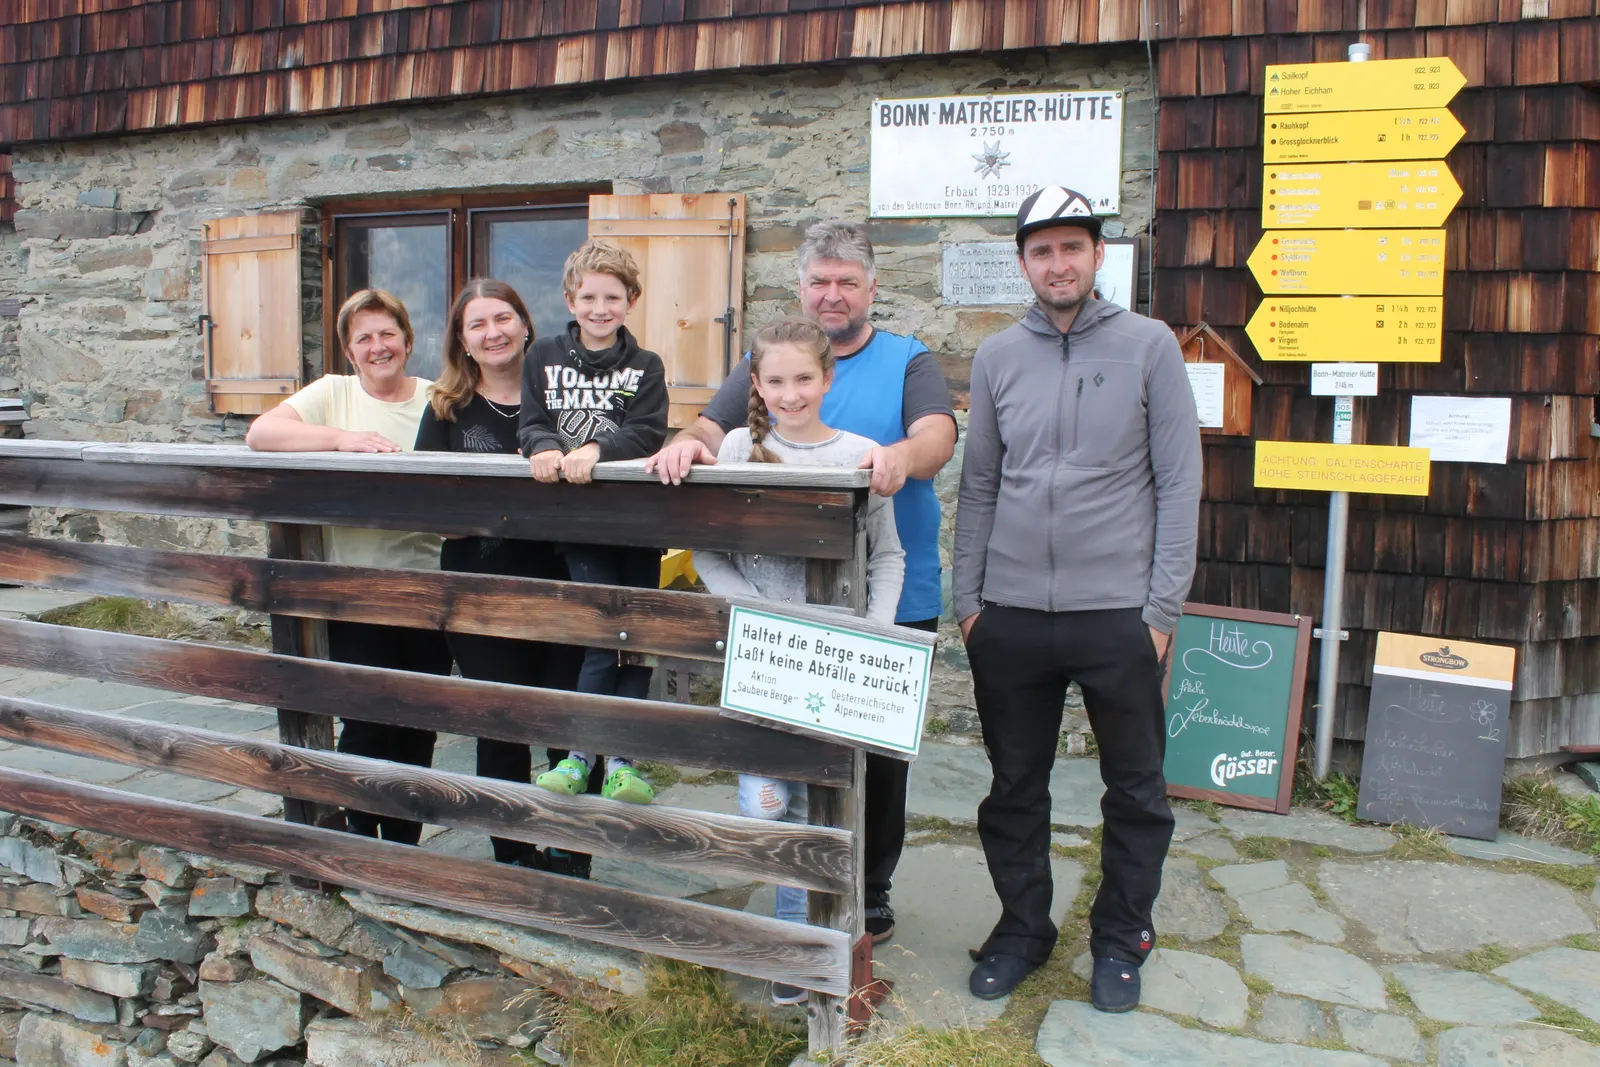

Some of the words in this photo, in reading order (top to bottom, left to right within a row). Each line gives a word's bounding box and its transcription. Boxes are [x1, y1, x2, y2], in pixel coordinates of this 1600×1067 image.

[1280, 88, 1301, 96] Hoher
[1304, 87, 1333, 95] Eichham
[970, 126, 1005, 137] 2.750
[1280, 121, 1309, 130] Rauhkopf
[1279, 136, 1339, 147] Grossglocknerblick
[945, 185, 978, 197] Erbaut
[987, 183, 1039, 197] 1929-1932
[878, 203, 890, 211] von
[892, 201, 905, 211] den
[906, 200, 942, 211] Sektionen
[968, 283, 996, 298] alpine
[1279, 305, 1317, 314] Nilljochhütte
[1279, 320, 1309, 328] Bodenalm
[1399, 320, 1403, 328] 2
[1278, 336, 1298, 345] Virgen
[544, 365, 644, 392] VOLUME
[544, 390, 557, 400] TO
[562, 389, 615, 411] MAX
[545, 399, 563, 410] THE
[1260, 468, 1291, 479] HOHE
[742, 623, 783, 645] Haltet
[788, 633, 808, 651] die
[815, 640, 854, 664] Berge
[1210, 622, 1250, 658] Heute
[737, 643, 765, 663] Laßt
[769, 650, 803, 672] keine
[808, 659, 856, 684] Abfälle
[1422, 654, 1466, 667] STRONGBOW
[751, 670, 777, 685] Aktion
[831, 688, 906, 715] Oesterreichischer
[834, 704, 885, 724] Alpenverein
[1210, 752, 1279, 787] Gösser
